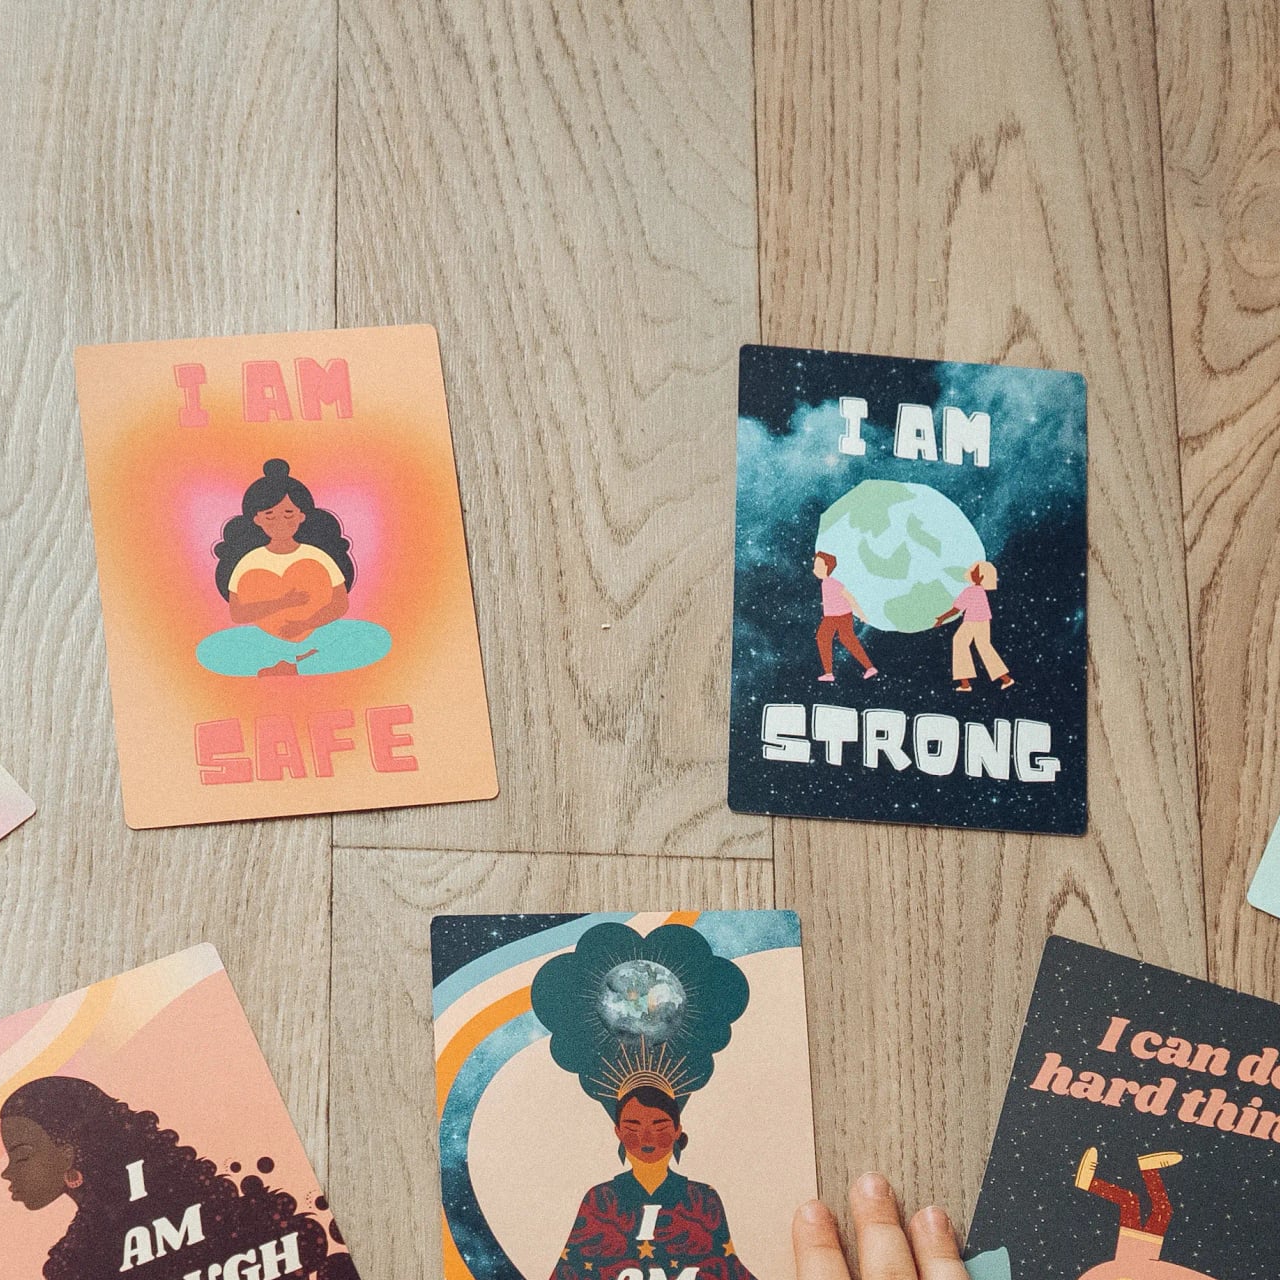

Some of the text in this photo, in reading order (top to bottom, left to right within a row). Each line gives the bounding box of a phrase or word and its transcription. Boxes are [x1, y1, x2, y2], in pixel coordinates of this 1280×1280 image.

[173, 357, 353, 428] I AM
[838, 396, 991, 467] I AM
[194, 704, 419, 785] SAFE
[761, 703, 1061, 782] STRONG
[1097, 1016, 1131, 1055] I
[1130, 1025, 1228, 1078] can
[1029, 1052, 1178, 1117] hard
[125, 1159, 148, 1202] I
[120, 1203, 205, 1273] AM
[635, 1204, 663, 1241] I
